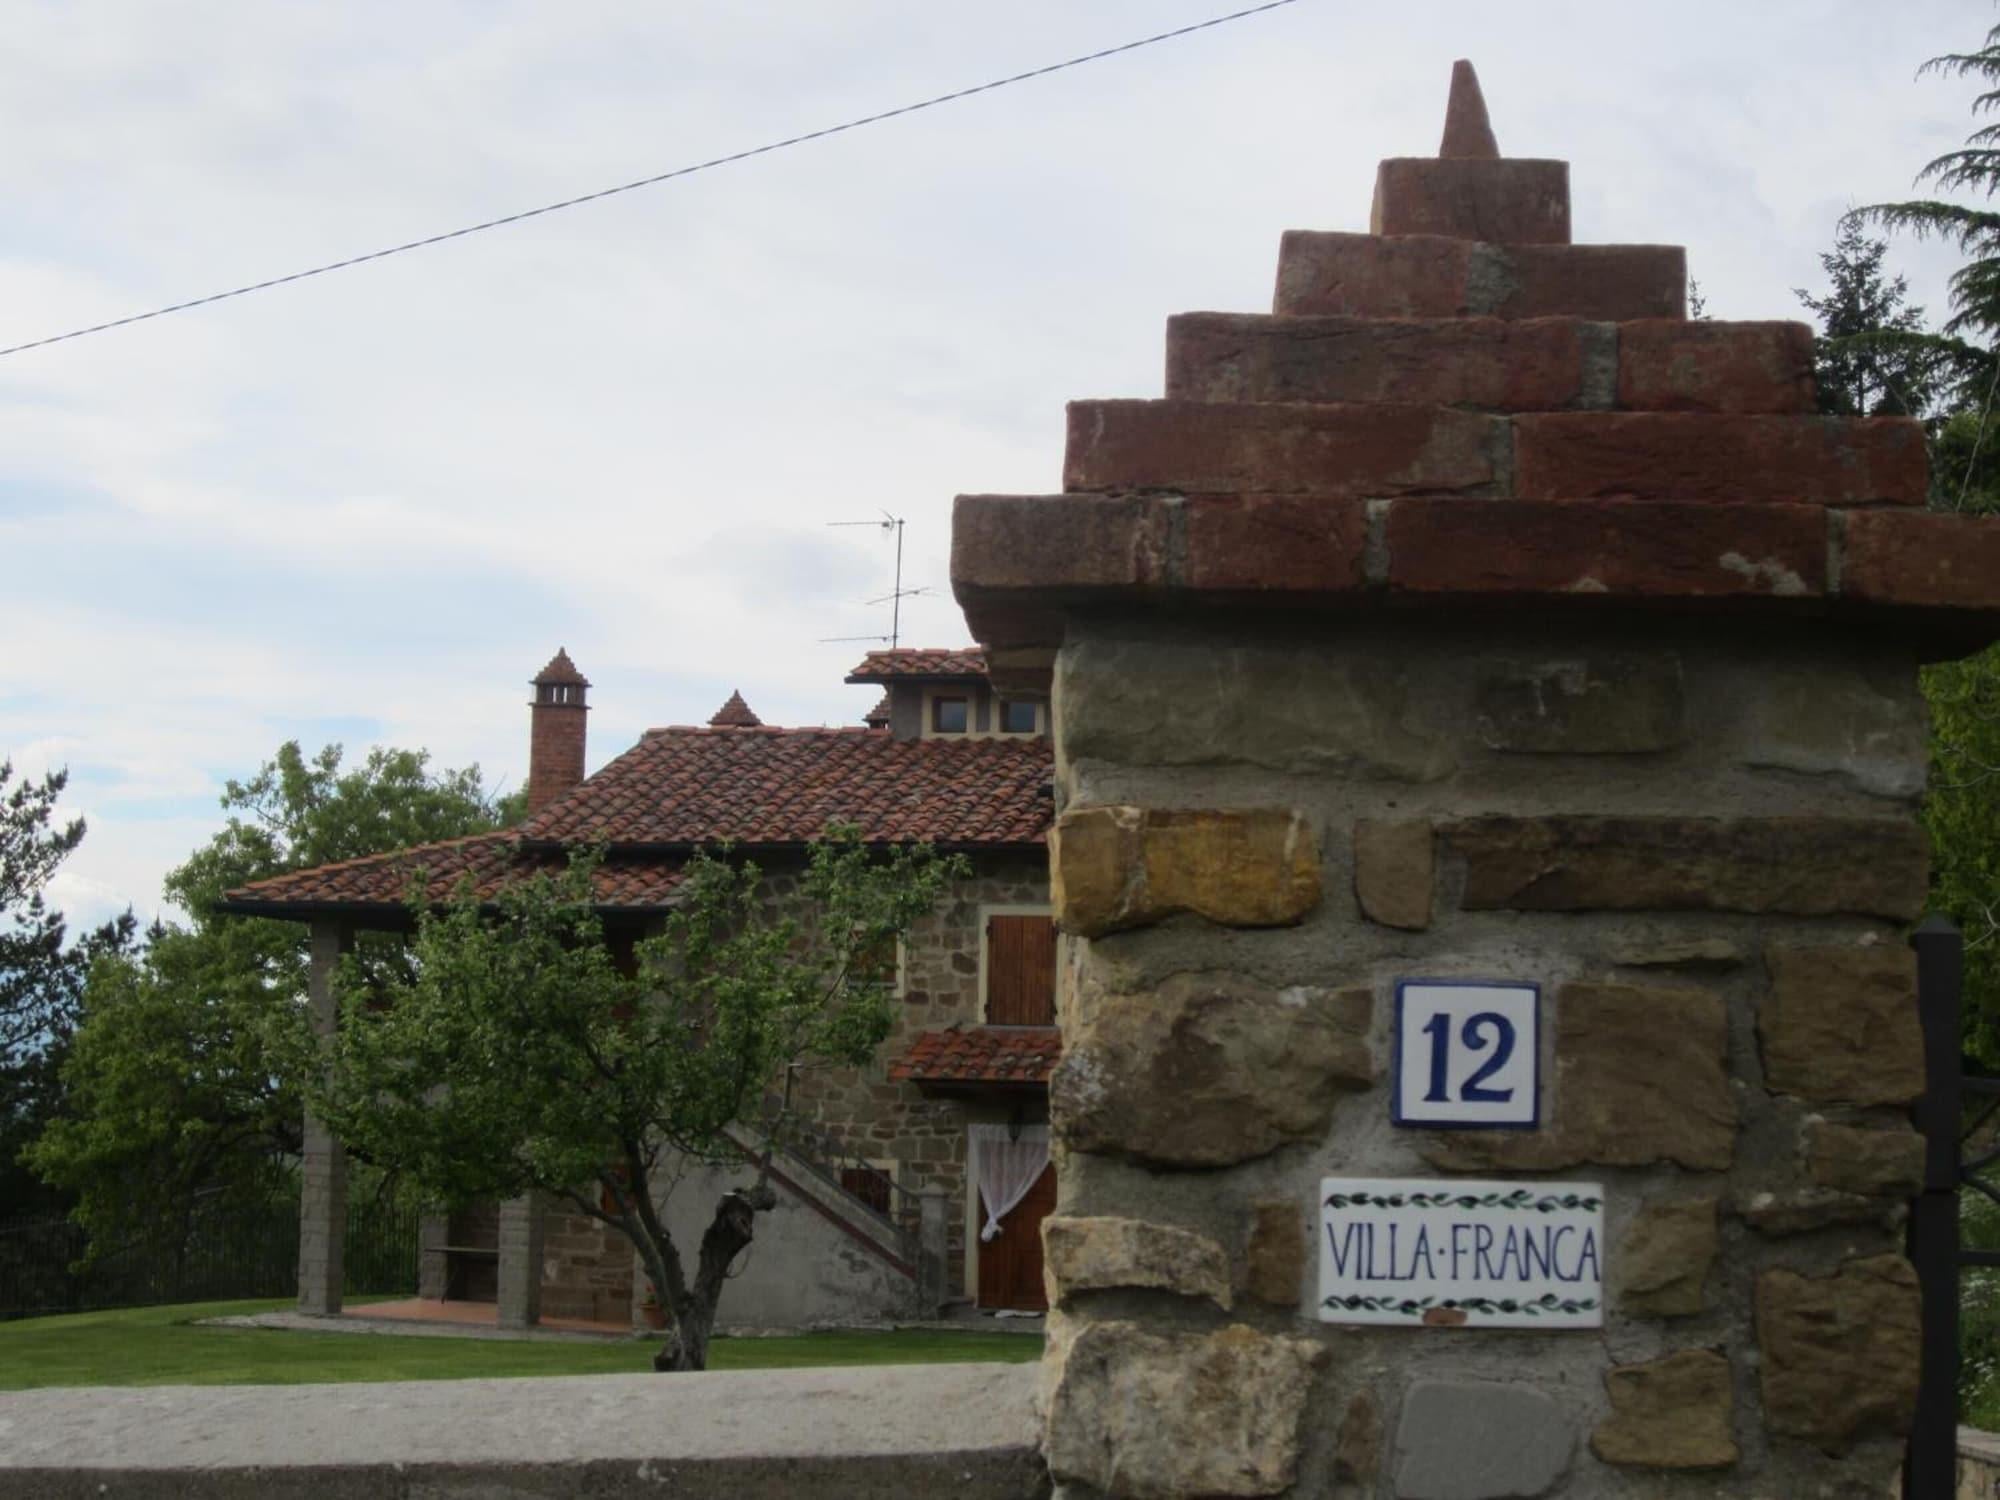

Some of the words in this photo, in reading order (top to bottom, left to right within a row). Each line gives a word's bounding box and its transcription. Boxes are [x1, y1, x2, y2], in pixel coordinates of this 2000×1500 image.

[1421, 1011, 1517, 1104] 12
[1325, 1221, 1437, 1282] VILLA
[1450, 1223, 1601, 1283] FRANCA
